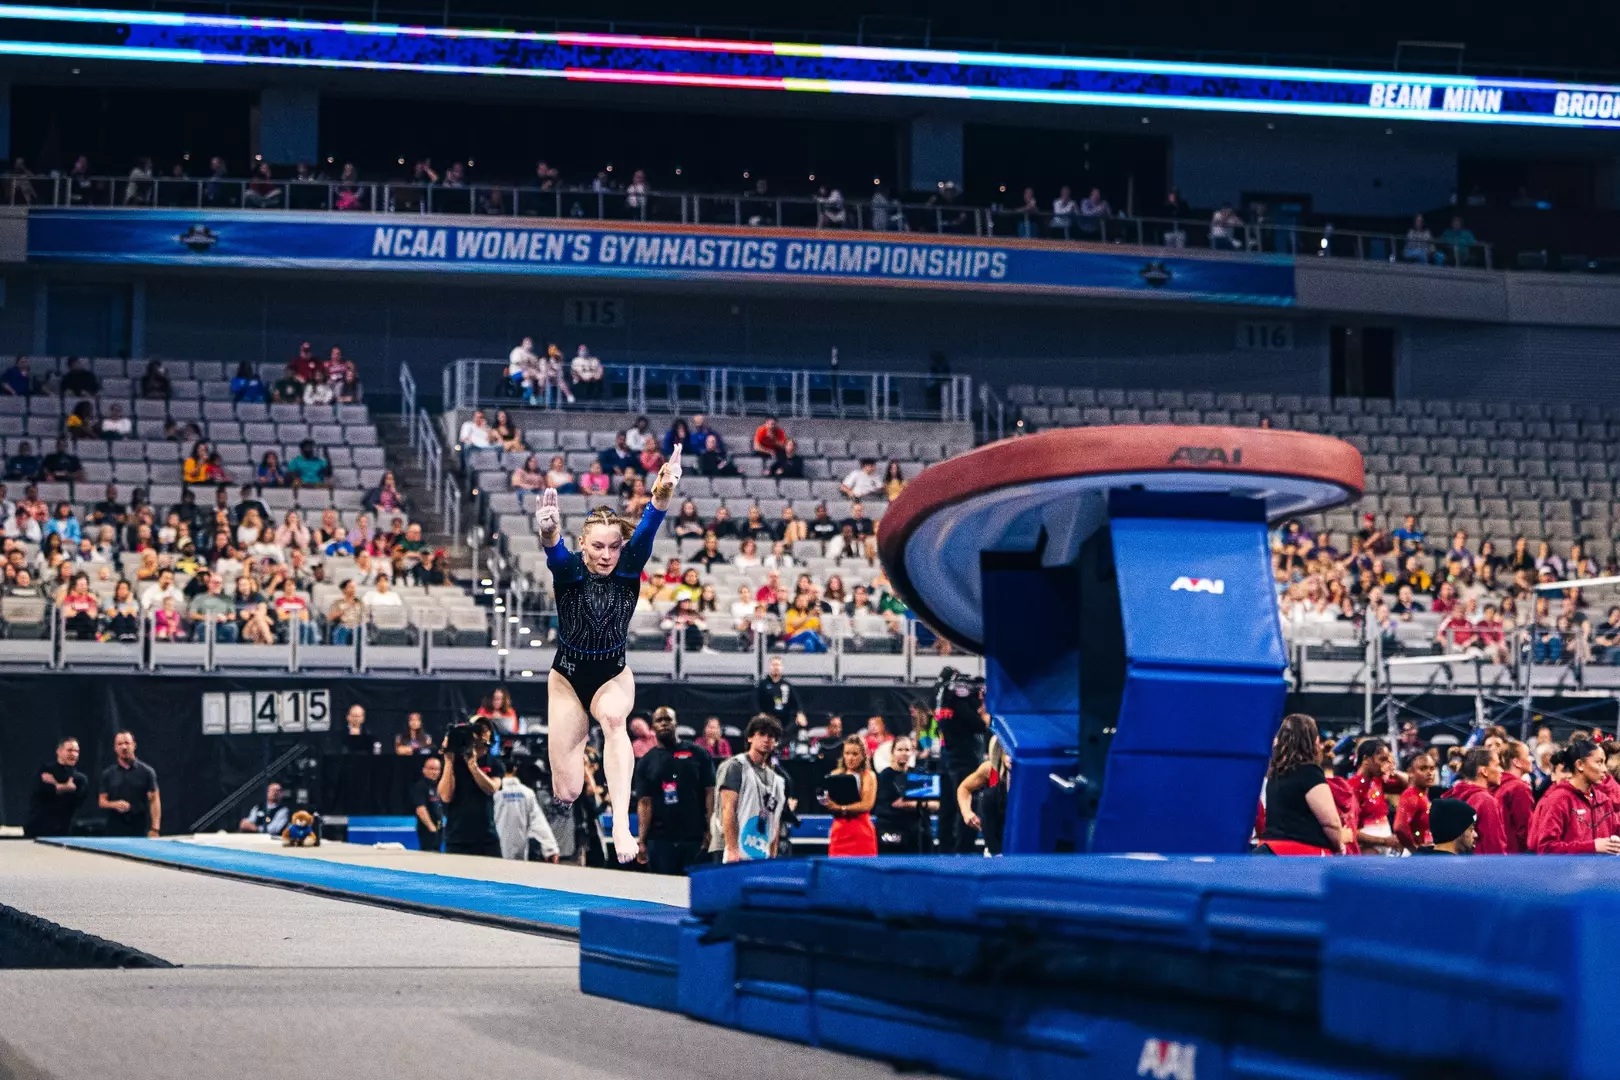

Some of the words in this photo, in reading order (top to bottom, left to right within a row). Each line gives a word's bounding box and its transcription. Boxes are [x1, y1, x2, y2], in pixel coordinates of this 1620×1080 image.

[1369, 82, 1432, 110] BEAM
[1443, 86, 1503, 113] MINN
[372, 227, 448, 258] NCAA
[456, 230, 592, 262] WOMEN'S
[599, 235, 778, 270] GYMNASTICS
[785, 241, 1008, 279] CHAMPIONSHIPS
[575, 300, 616, 324] 115
[1245, 324, 1286, 347] 116
[257, 691, 328, 723] 415
